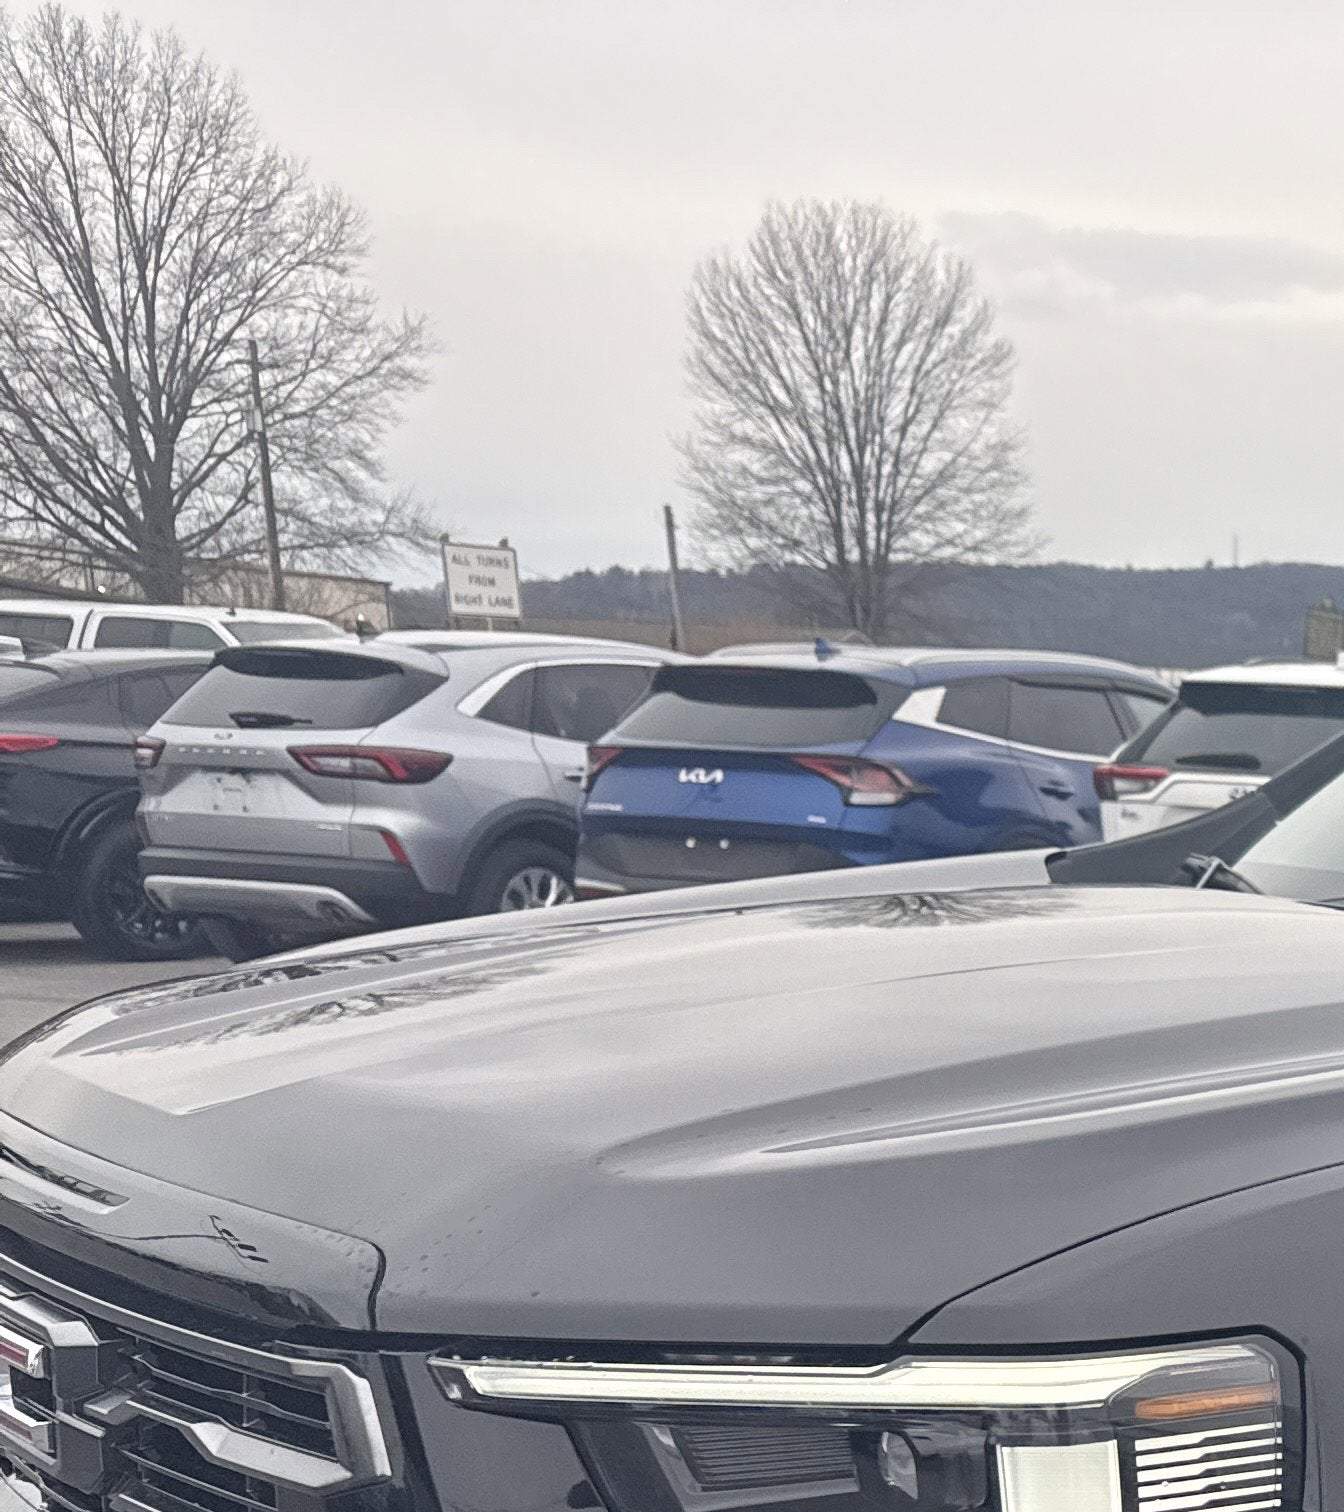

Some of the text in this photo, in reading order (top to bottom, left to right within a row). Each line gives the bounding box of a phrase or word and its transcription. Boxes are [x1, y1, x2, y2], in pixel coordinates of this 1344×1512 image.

[451, 553, 510, 570] ALL TURNS
[468, 573, 496, 588] FROM
[454, 592, 514, 609] RIGHT LANE
[678, 767, 724, 784] KIA
